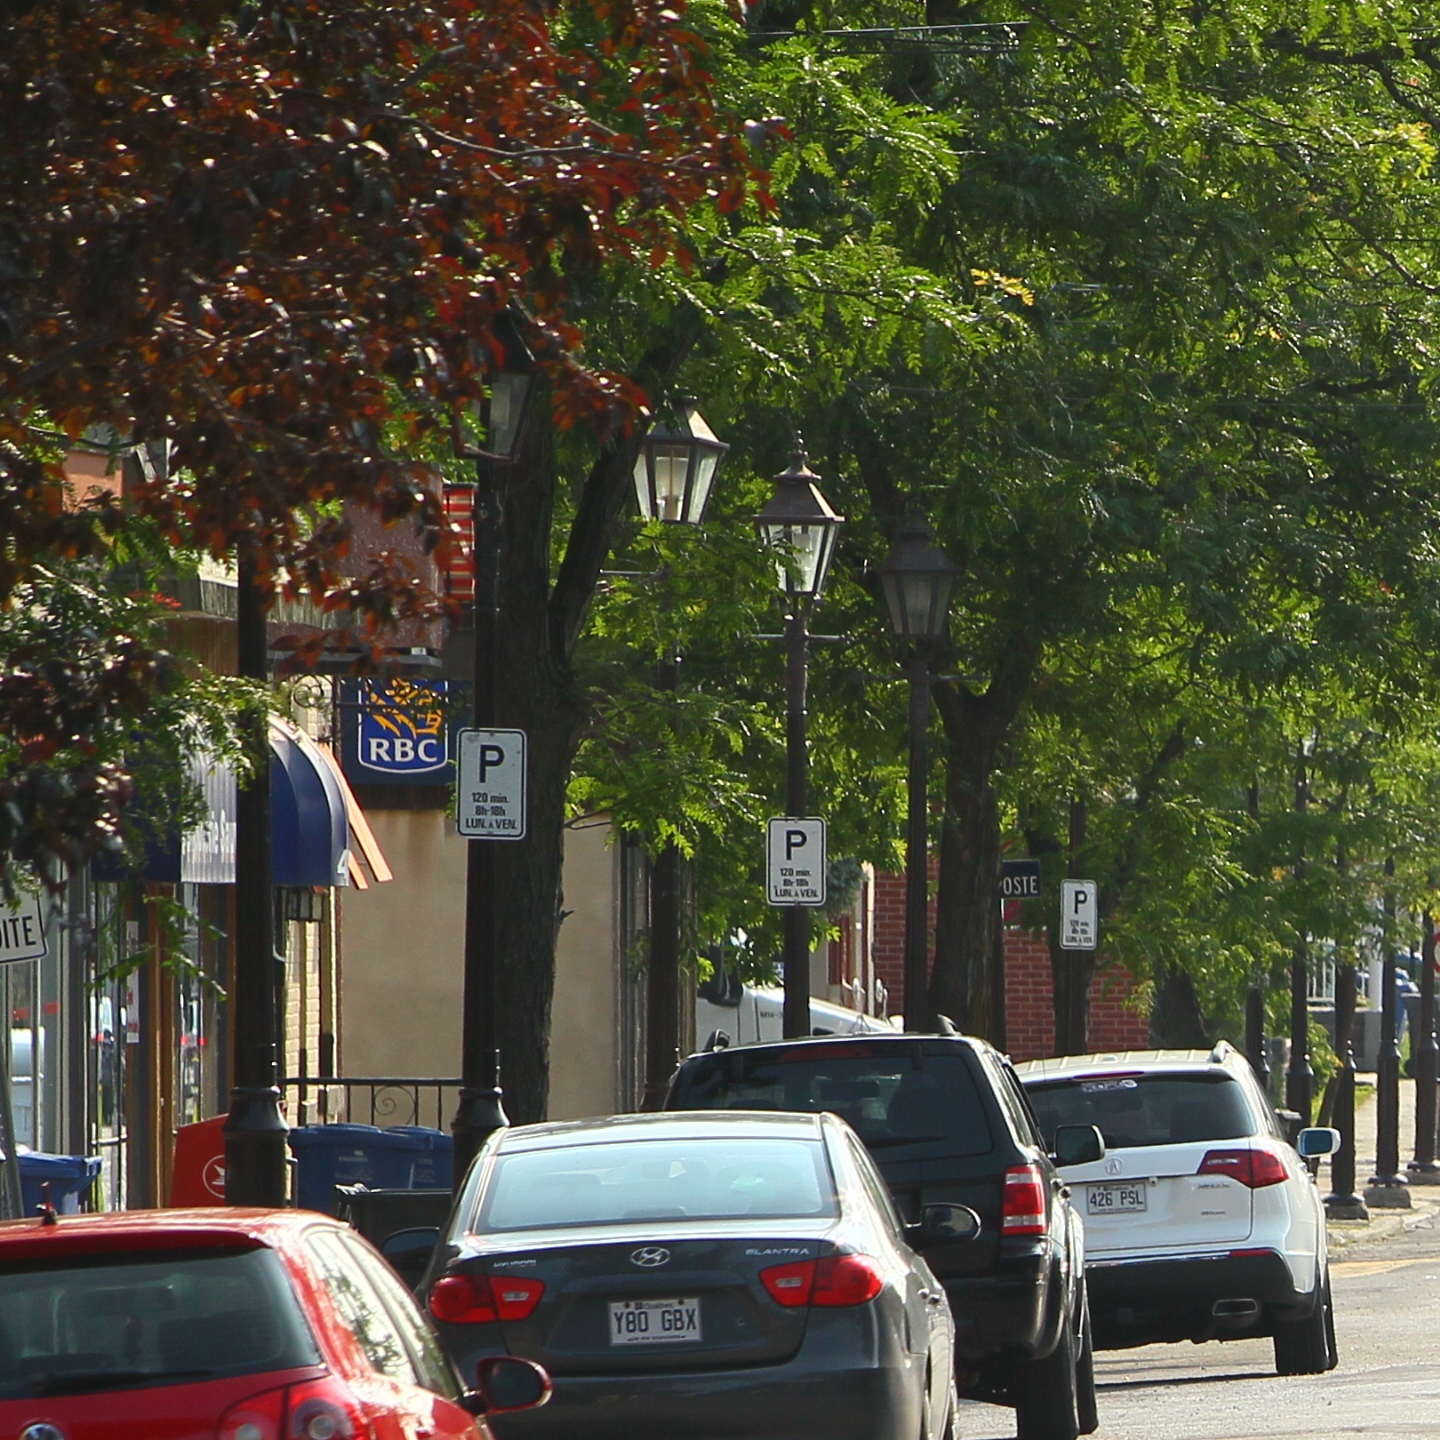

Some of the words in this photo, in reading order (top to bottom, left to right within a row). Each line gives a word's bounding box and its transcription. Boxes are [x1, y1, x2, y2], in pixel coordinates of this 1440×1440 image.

[368, 738, 438, 762] RBC
[479, 744, 505, 784] P
[471, 792, 488, 803] 120
[490, 792, 510, 803] min.
[475, 805, 506, 816] 8h-18h
[786, 830, 807, 860] P
[1074, 890, 1088, 914] P
[1090, 1192, 1113, 1207] 426
[1120, 1191, 1143, 1205] PSL
[745, 1248, 810, 1256] ELANTRA
[614, 1309, 649, 1334] Y80
[661, 1308, 697, 1333] GBX
